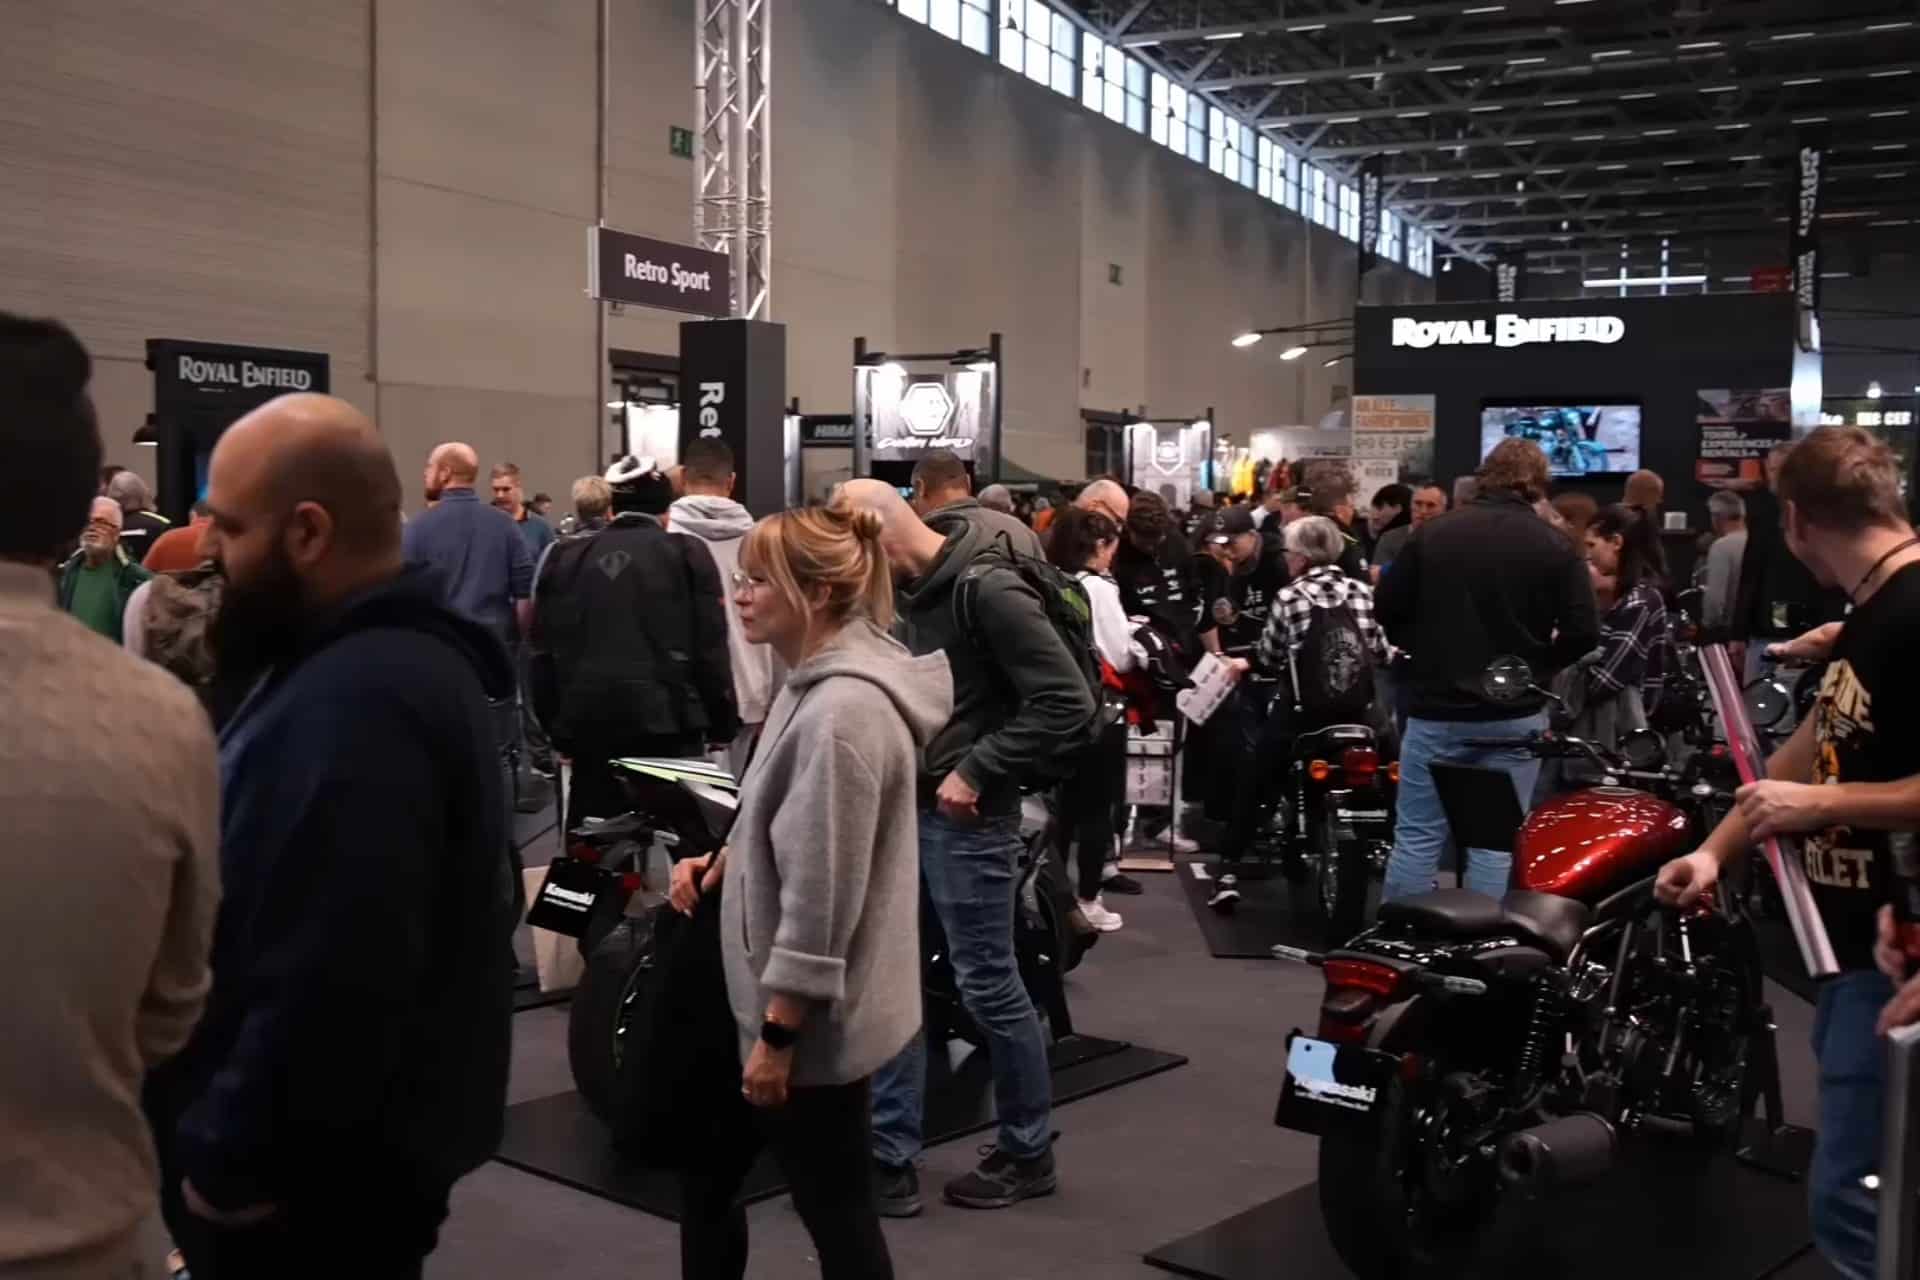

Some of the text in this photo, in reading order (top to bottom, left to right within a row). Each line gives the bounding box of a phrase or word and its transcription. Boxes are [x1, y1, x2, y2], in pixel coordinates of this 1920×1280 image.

[624, 252, 711, 293] Retro Sport
[1392, 314, 1625, 348] ROYAL ENFIELD
[178, 355, 312, 390] ROYAL ENFIELD
